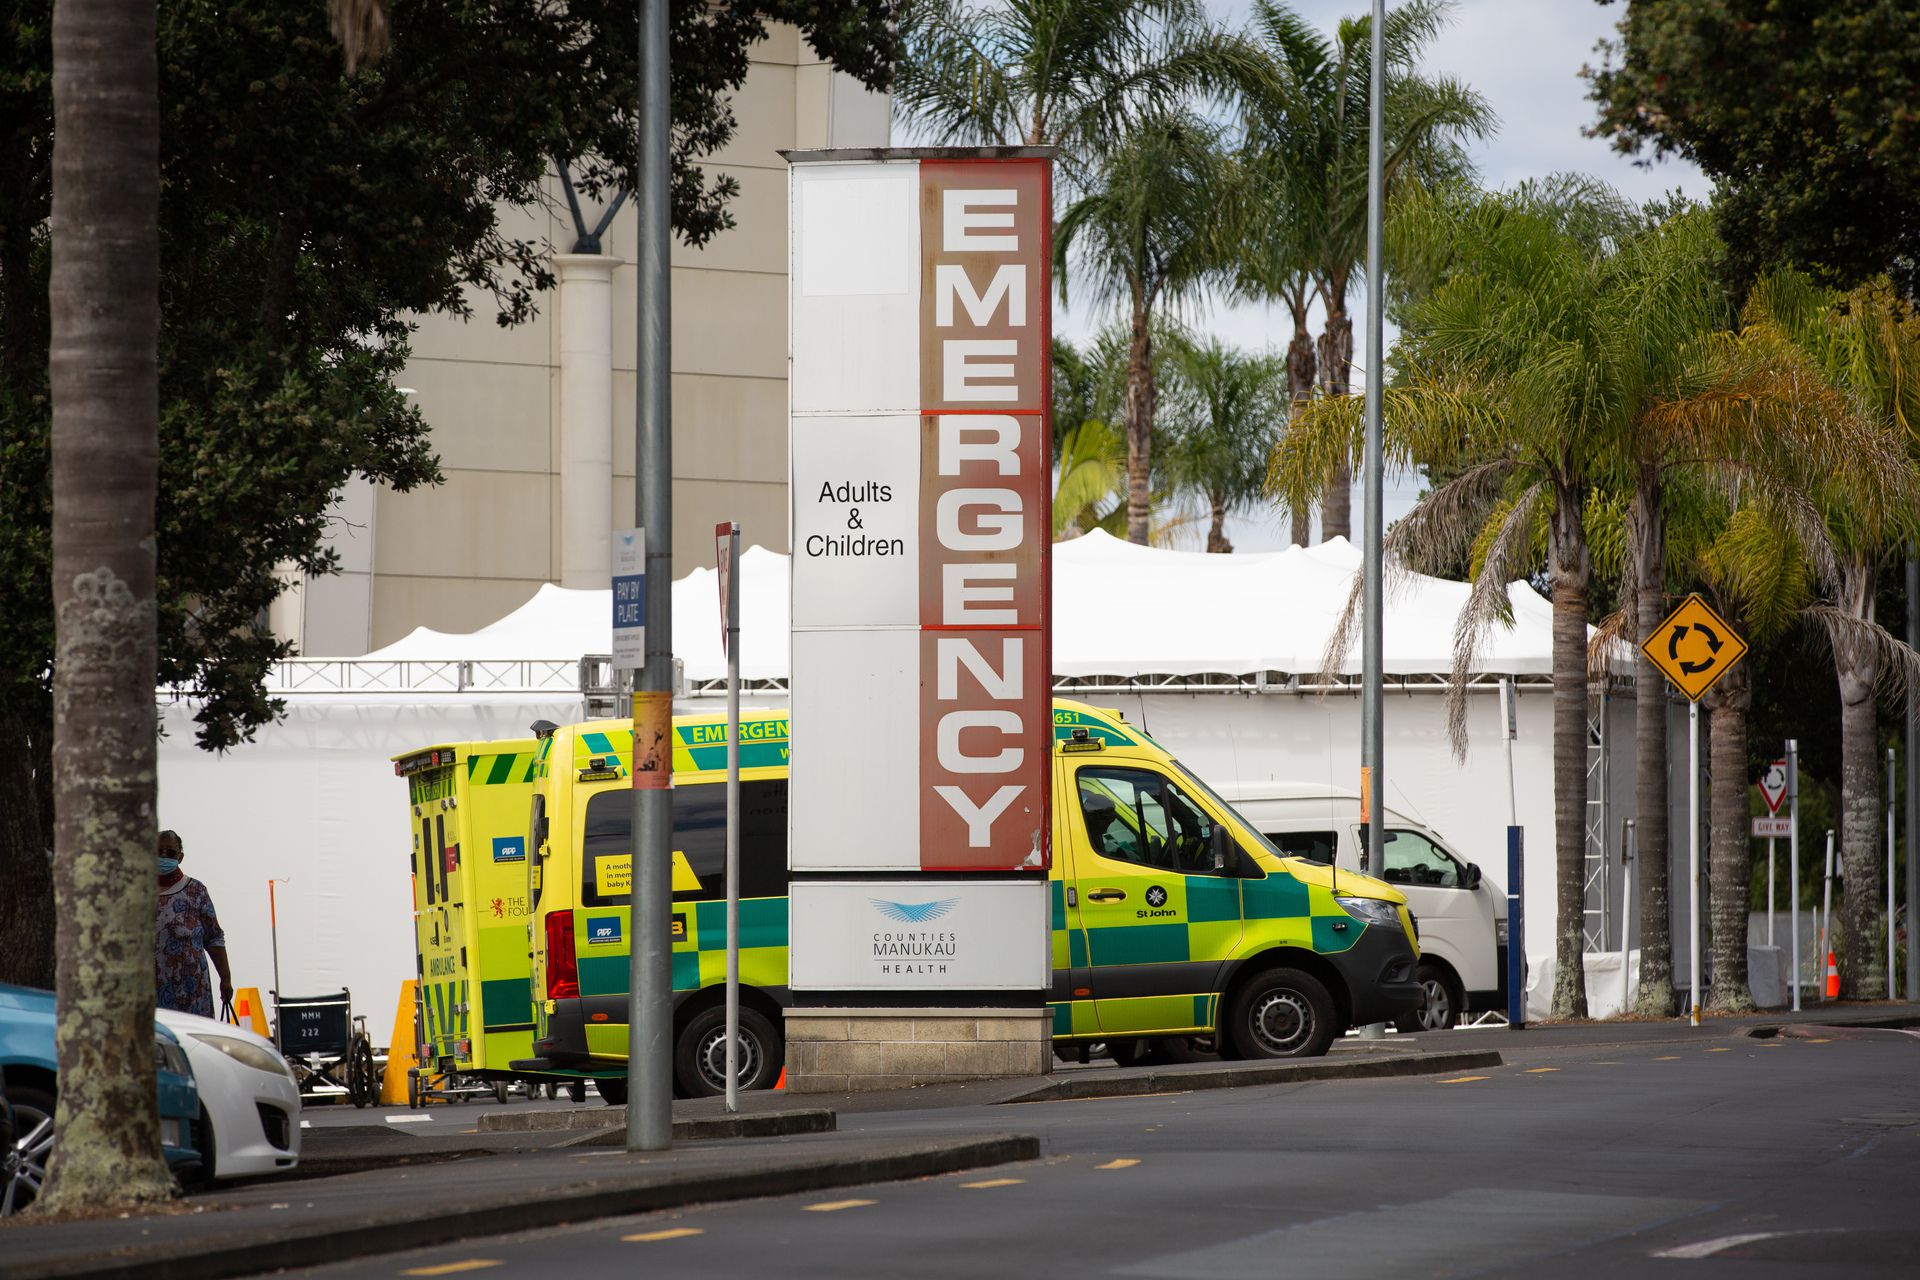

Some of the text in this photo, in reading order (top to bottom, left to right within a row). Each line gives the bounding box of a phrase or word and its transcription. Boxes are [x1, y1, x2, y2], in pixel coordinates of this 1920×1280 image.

[818, 480, 893, 504] Adults
[847, 508, 864, 530] &
[932, 189, 1028, 848] EMERGENCY
[806, 535, 904, 557] Children
[617, 581, 640, 600] PAY BY
[618, 603, 639, 622] PLATE
[1054, 712, 1080, 724] 651
[1759, 823, 1789, 833] GIVE WAY
[612, 862, 632, 870] moth
[607, 880, 624, 889] baby
[507, 896, 525, 906] THE
[1136, 909, 1177, 919] St John
[873, 933, 956, 942] COUNTIES
[873, 943, 956, 956] MANUKAU
[430, 955, 456, 977] AMBULANCE
[882, 964, 947, 974] HEALTH
[301, 1011, 321, 1020] MMH
[301, 1028, 319, 1037] 222
